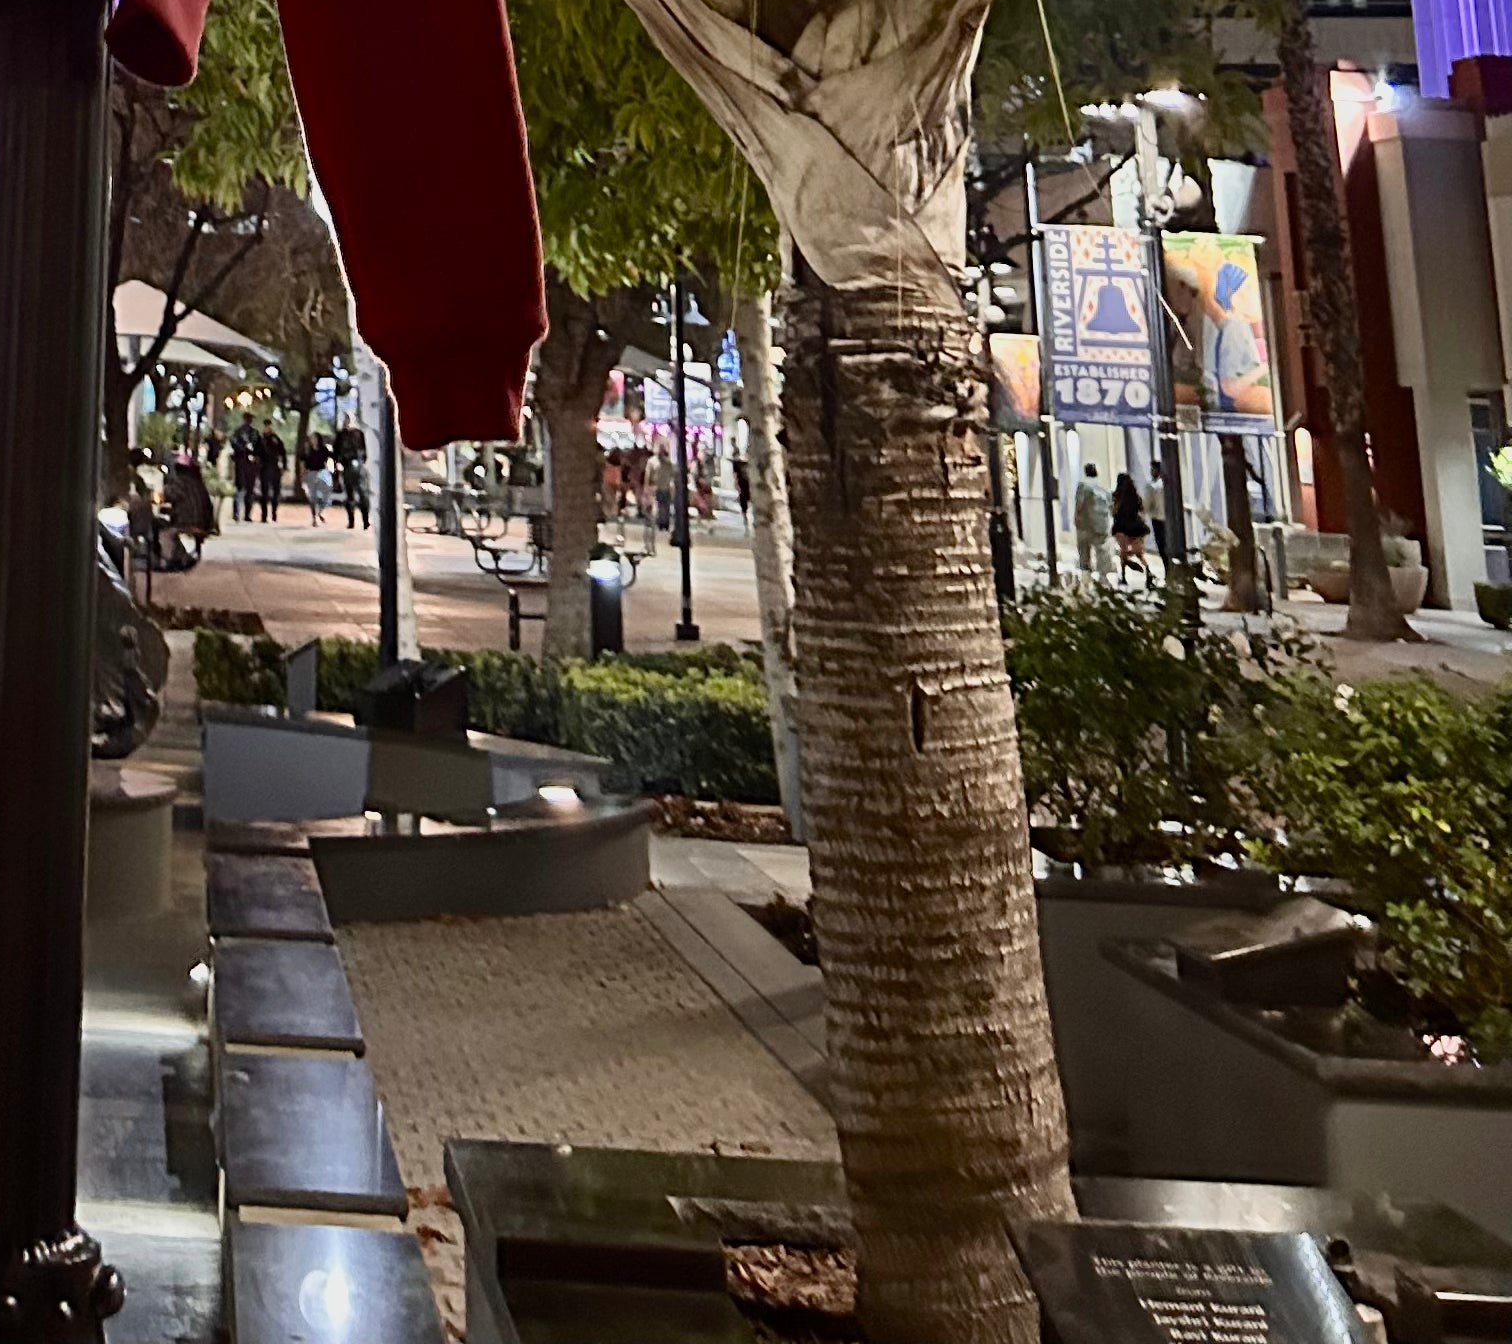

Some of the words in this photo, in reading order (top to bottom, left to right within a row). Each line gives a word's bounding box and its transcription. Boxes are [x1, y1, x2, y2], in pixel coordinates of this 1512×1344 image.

[1049, 228, 1074, 353] RIVERSIDE
[1054, 363, 1150, 380] ESTABLISHED
[1054, 378, 1151, 409] 1870
